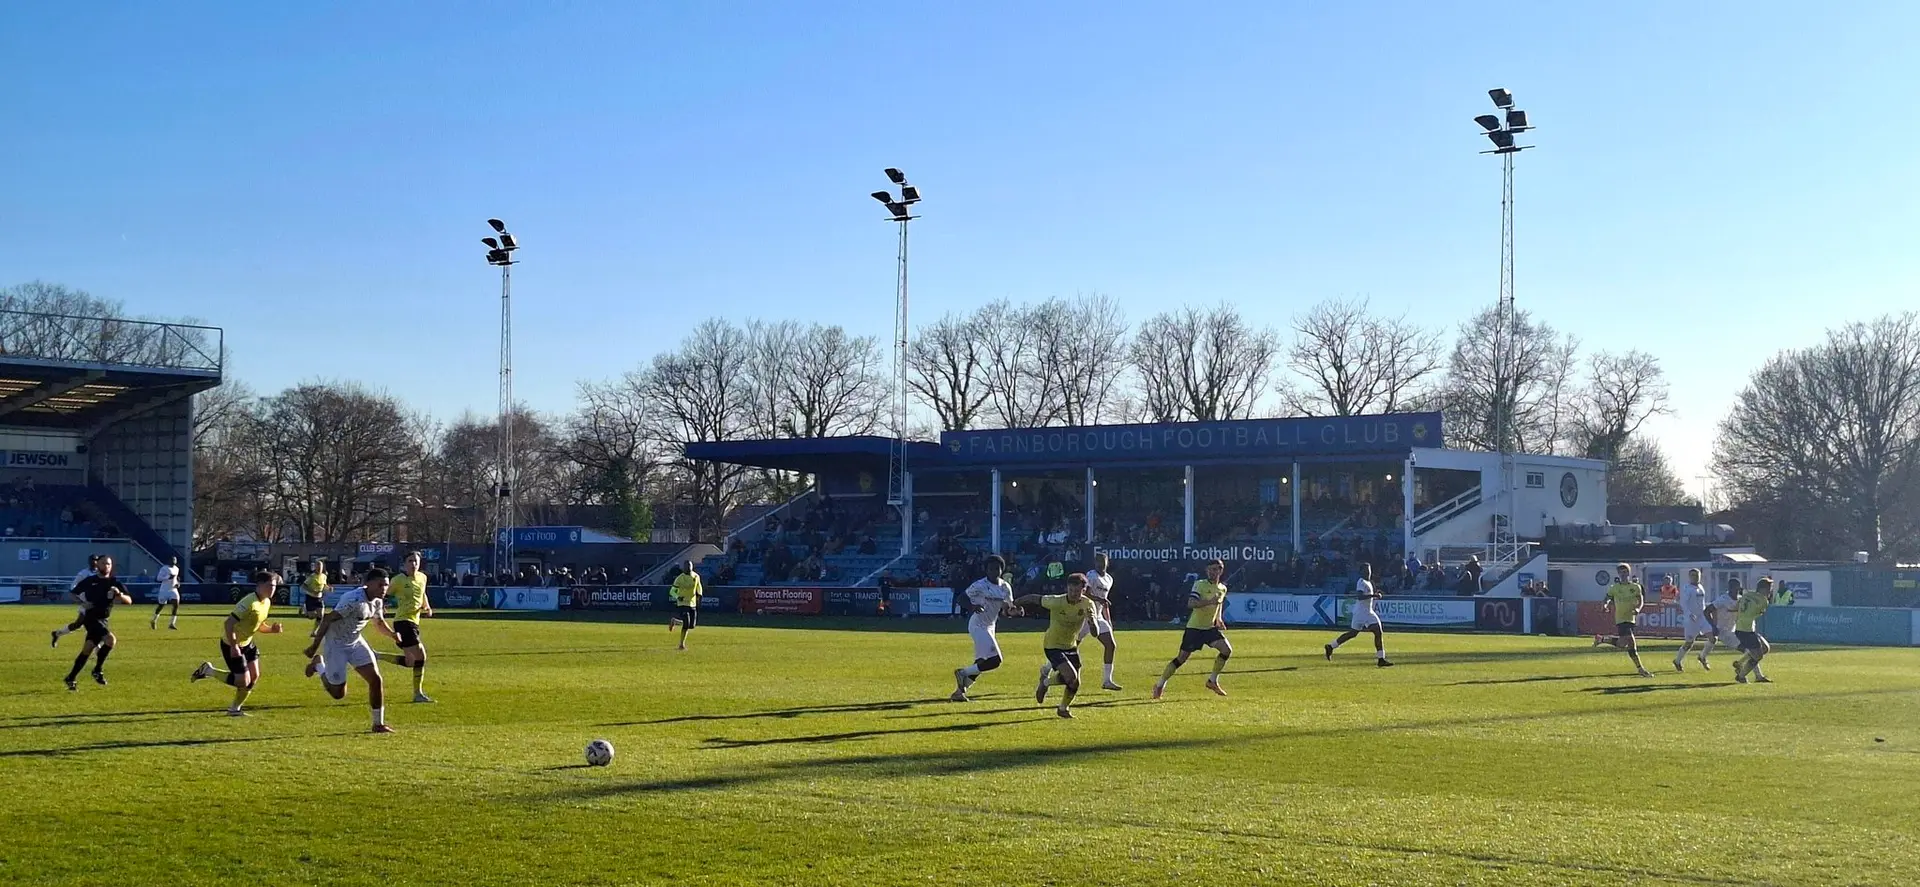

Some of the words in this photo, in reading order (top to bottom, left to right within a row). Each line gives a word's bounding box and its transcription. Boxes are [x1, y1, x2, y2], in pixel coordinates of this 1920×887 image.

[970, 429, 1154, 454] FARNBOROUGH
[1163, 424, 1308, 449] FOOTBALL
[1320, 421, 1400, 445] CLUB
[9, 453, 69, 467] JEWSON
[520, 532, 537, 541] FAST
[537, 532, 557, 541] FOOD
[359, 544, 376, 553] CLUB
[377, 544, 394, 553] SHOP
[1093, 546, 1179, 563] Farnborough
[1182, 545, 1239, 561] Football
[1242, 546, 1276, 562] Club
[591, 587, 626, 601] michael
[626, 587, 652, 601] usher
[754, 589, 782, 599] Vincent
[782, 589, 813, 601] Flooring
[1261, 600, 1300, 613] EVOLUTION
[1374, 601, 1444, 615] AWSERVICES
